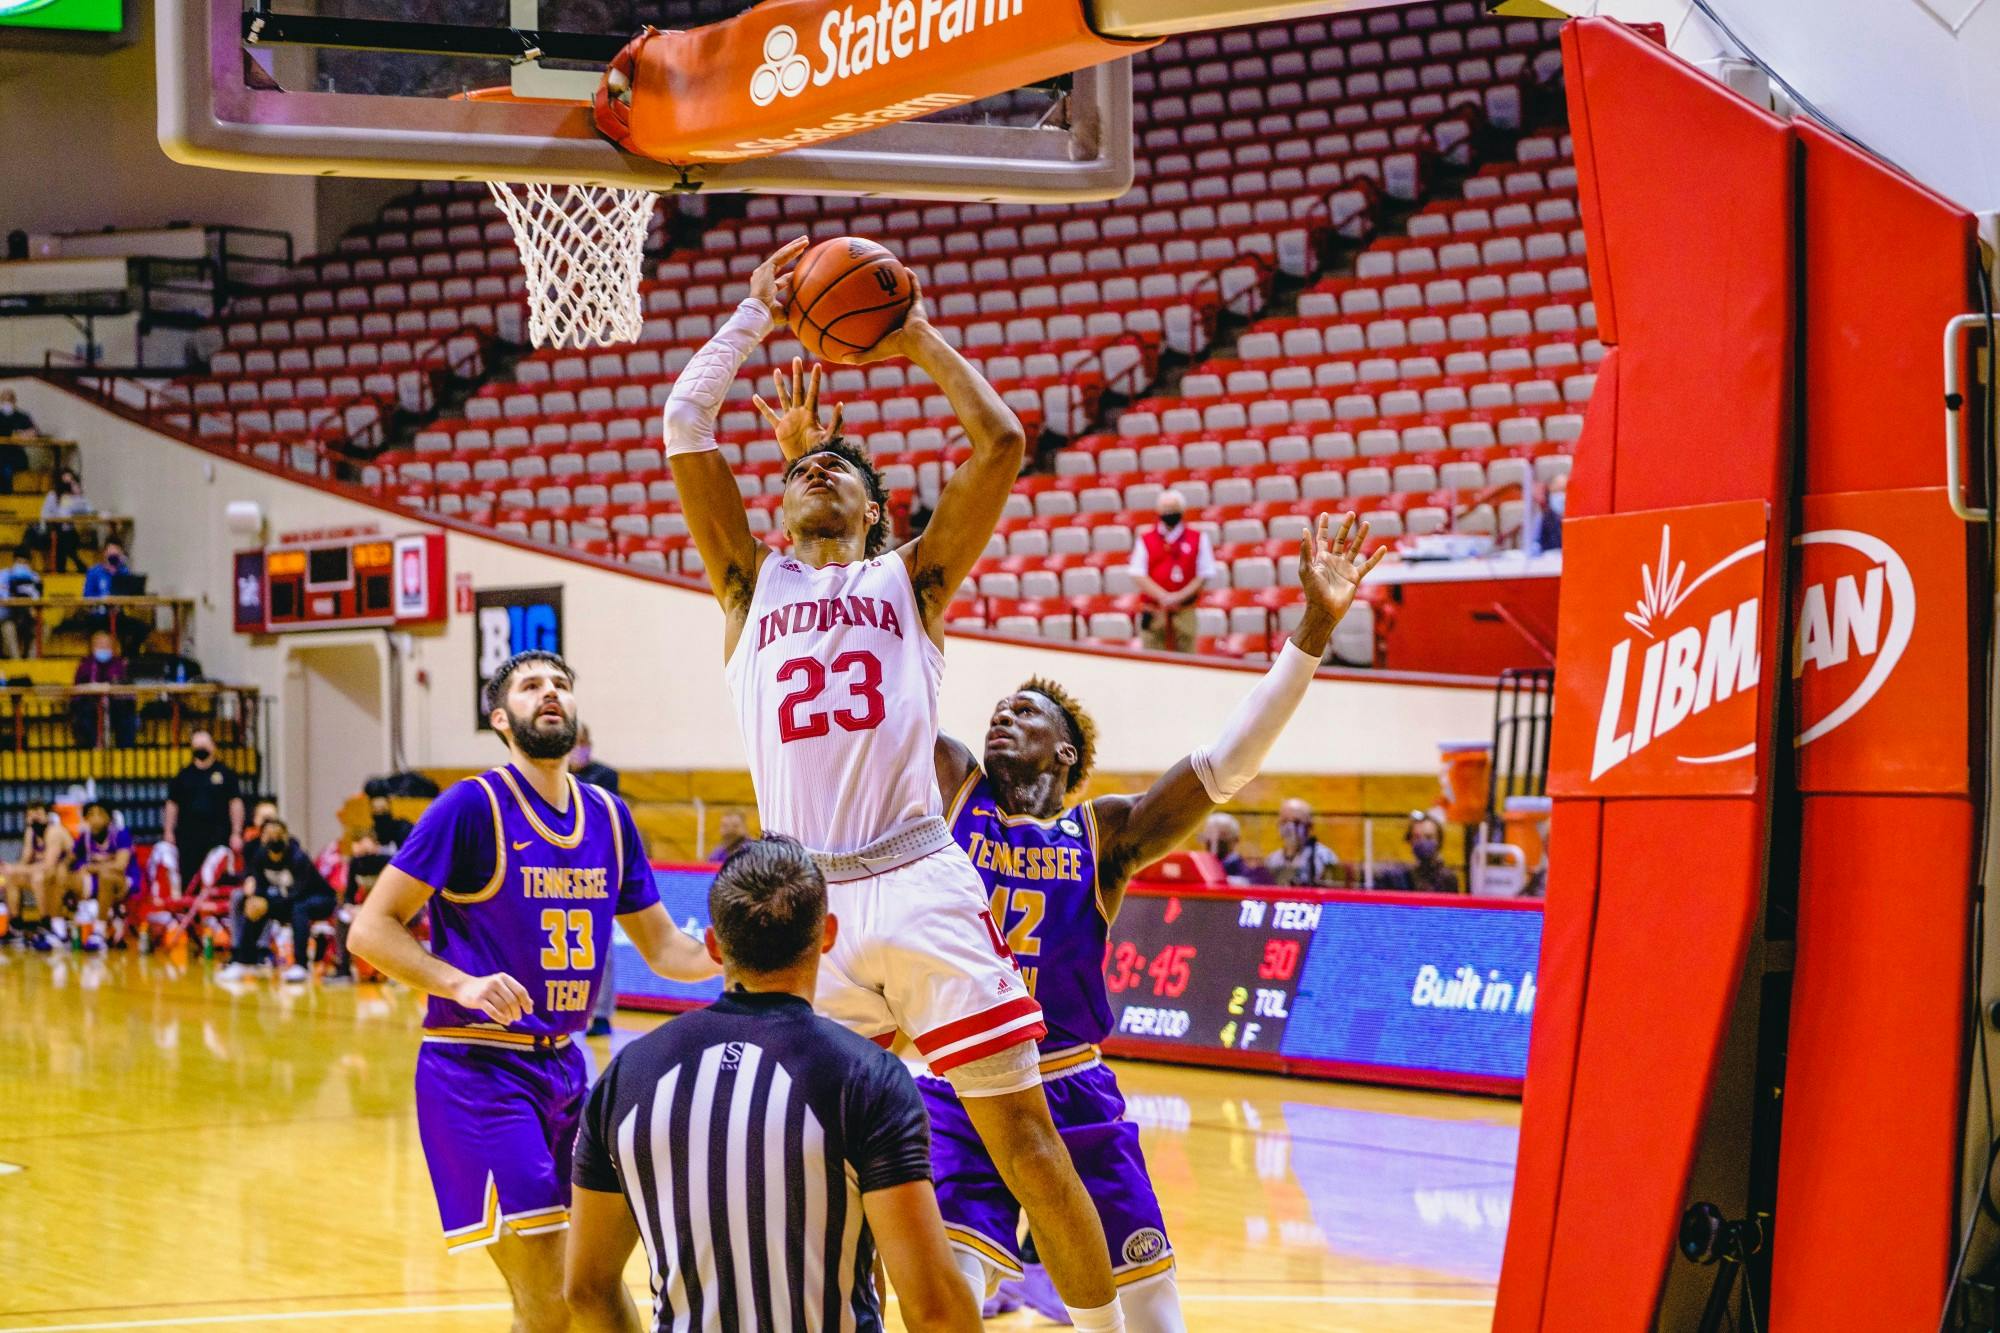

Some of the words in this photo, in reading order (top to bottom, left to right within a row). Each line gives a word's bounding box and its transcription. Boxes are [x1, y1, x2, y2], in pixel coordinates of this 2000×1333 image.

[757, 594, 904, 652] INDIANA
[776, 650, 886, 744] 23
[520, 866, 609, 899] TENNESSEE
[985, 883, 1046, 957] 12
[1238, 899, 1267, 928] TN
[1272, 901, 1322, 931] TECH
[540, 908, 596, 971] 33
[1258, 938, 1301, 980] 30
[545, 979, 591, 1012] TECH
[1228, 986, 1248, 1015] 2
[1254, 987, 1289, 1019] TOL
[1411, 964, 1482, 1011] Built
[1481, 969, 1514, 1012] in
[1119, 1005, 1191, 1038] PERIOD
[1220, 1020, 1238, 1049] 4
[1240, 1021, 1262, 1050] F
